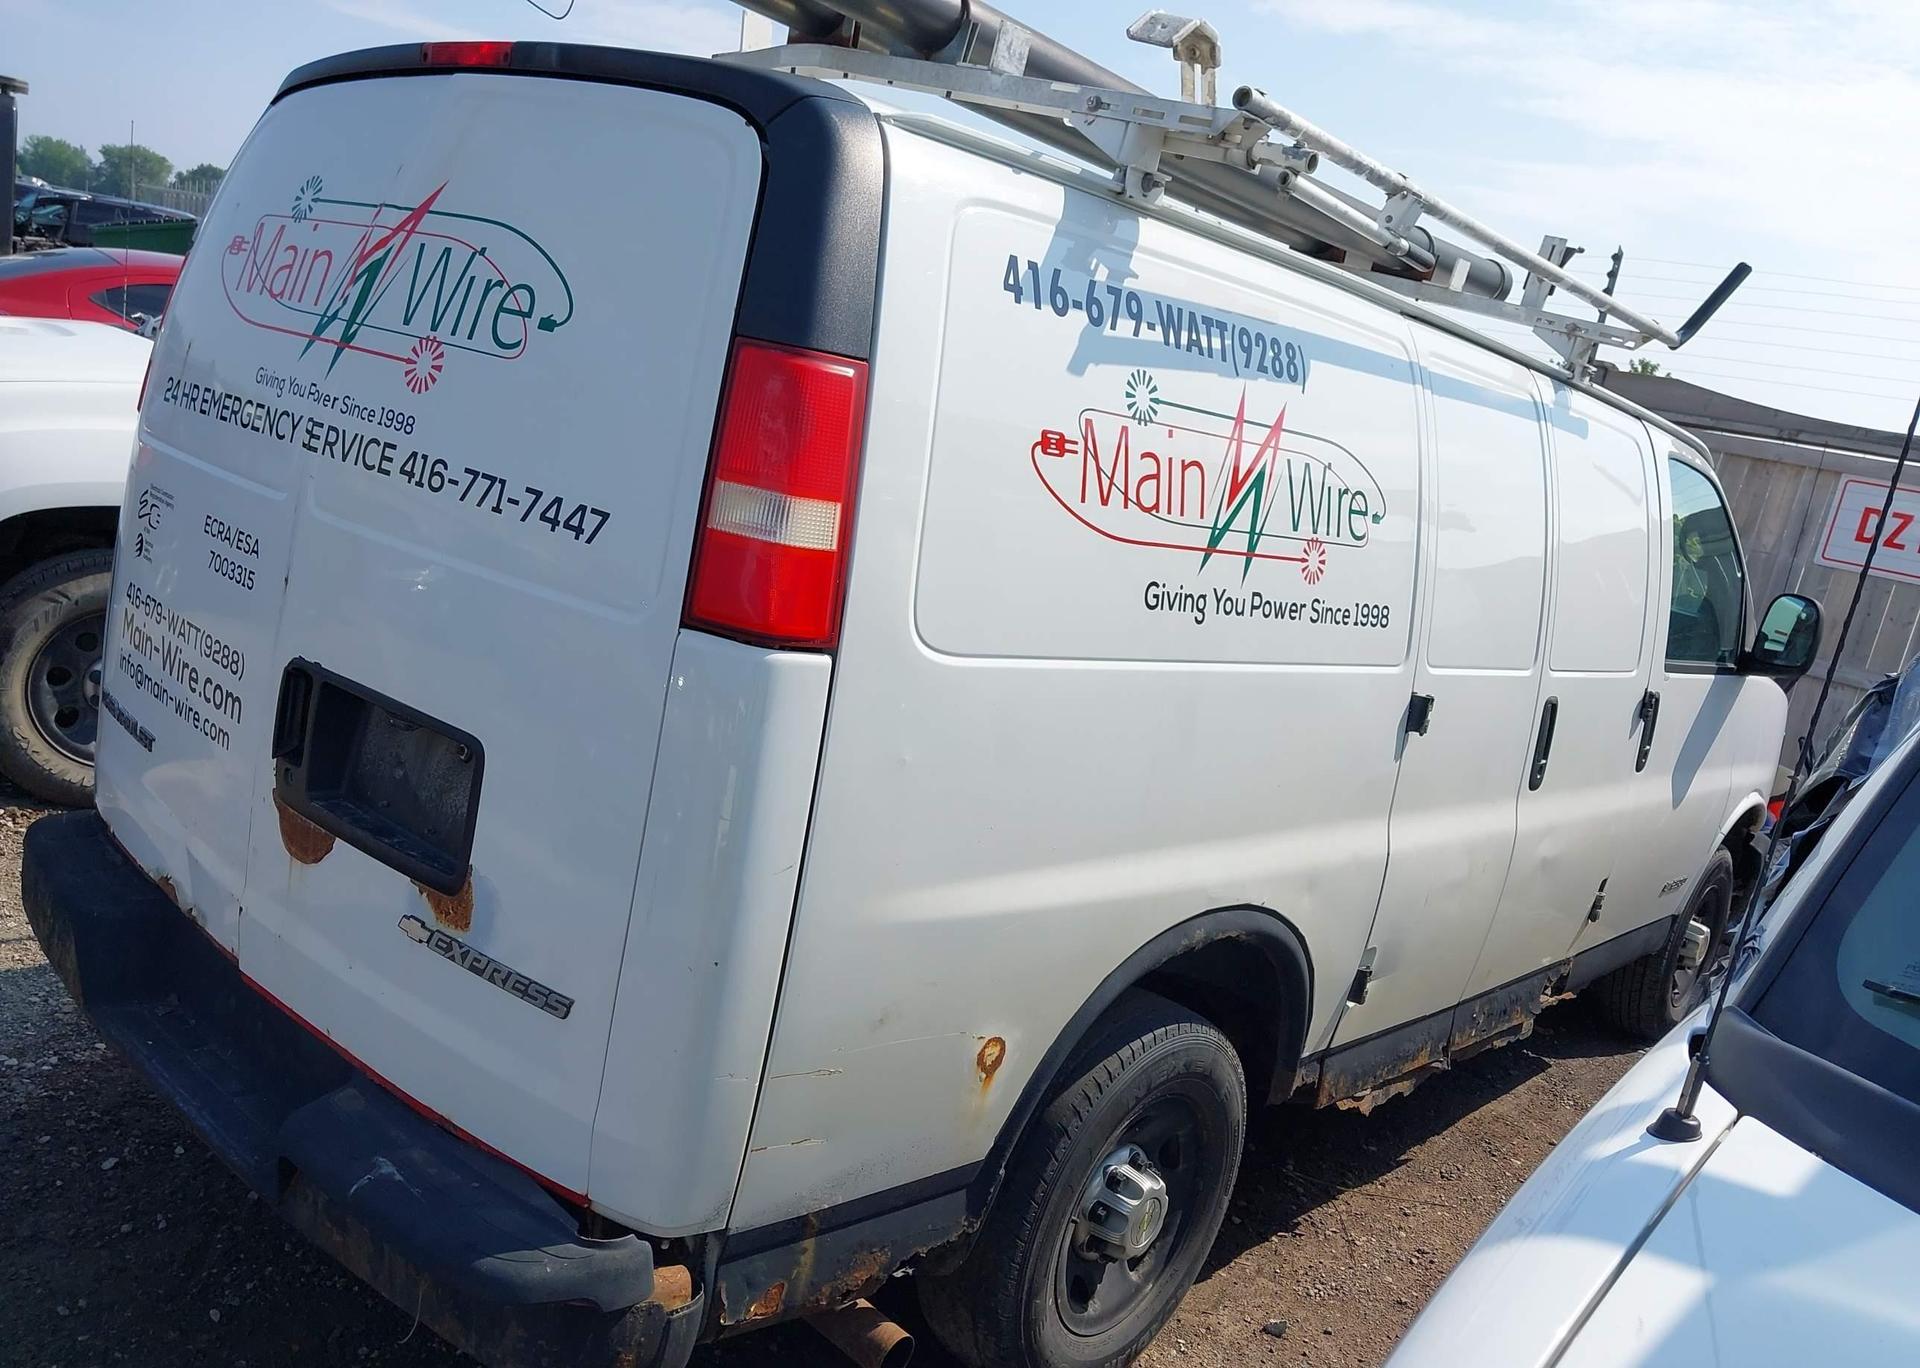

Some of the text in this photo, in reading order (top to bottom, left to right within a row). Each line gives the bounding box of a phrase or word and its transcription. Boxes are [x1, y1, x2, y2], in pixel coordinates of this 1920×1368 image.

[235, 222, 536, 350] Main Wire
[1003, 254, 1307, 395] 416-679-WATT(9288)
[255, 366, 286, 398] Giving
[288, 375, 307, 398] You
[340, 395, 376, 424] Since
[377, 406, 416, 435] 1998
[163, 376, 611, 546] 24 HR EMERGENCY SERVICE 416-771-7447
[1079, 417, 1370, 542] Main Wire
[203, 514, 260, 560] ECRA/ESA
[207, 549, 256, 592] 7003315
[126, 581, 246, 682] 416-679-WATT(9288)
[1144, 581, 1390, 629] Giving You Power Since 1998
[119, 648, 230, 751] info@main-wire.com
[121, 606, 243, 725] Main-Wire.com
[427, 930, 575, 1018] EXPRESS
